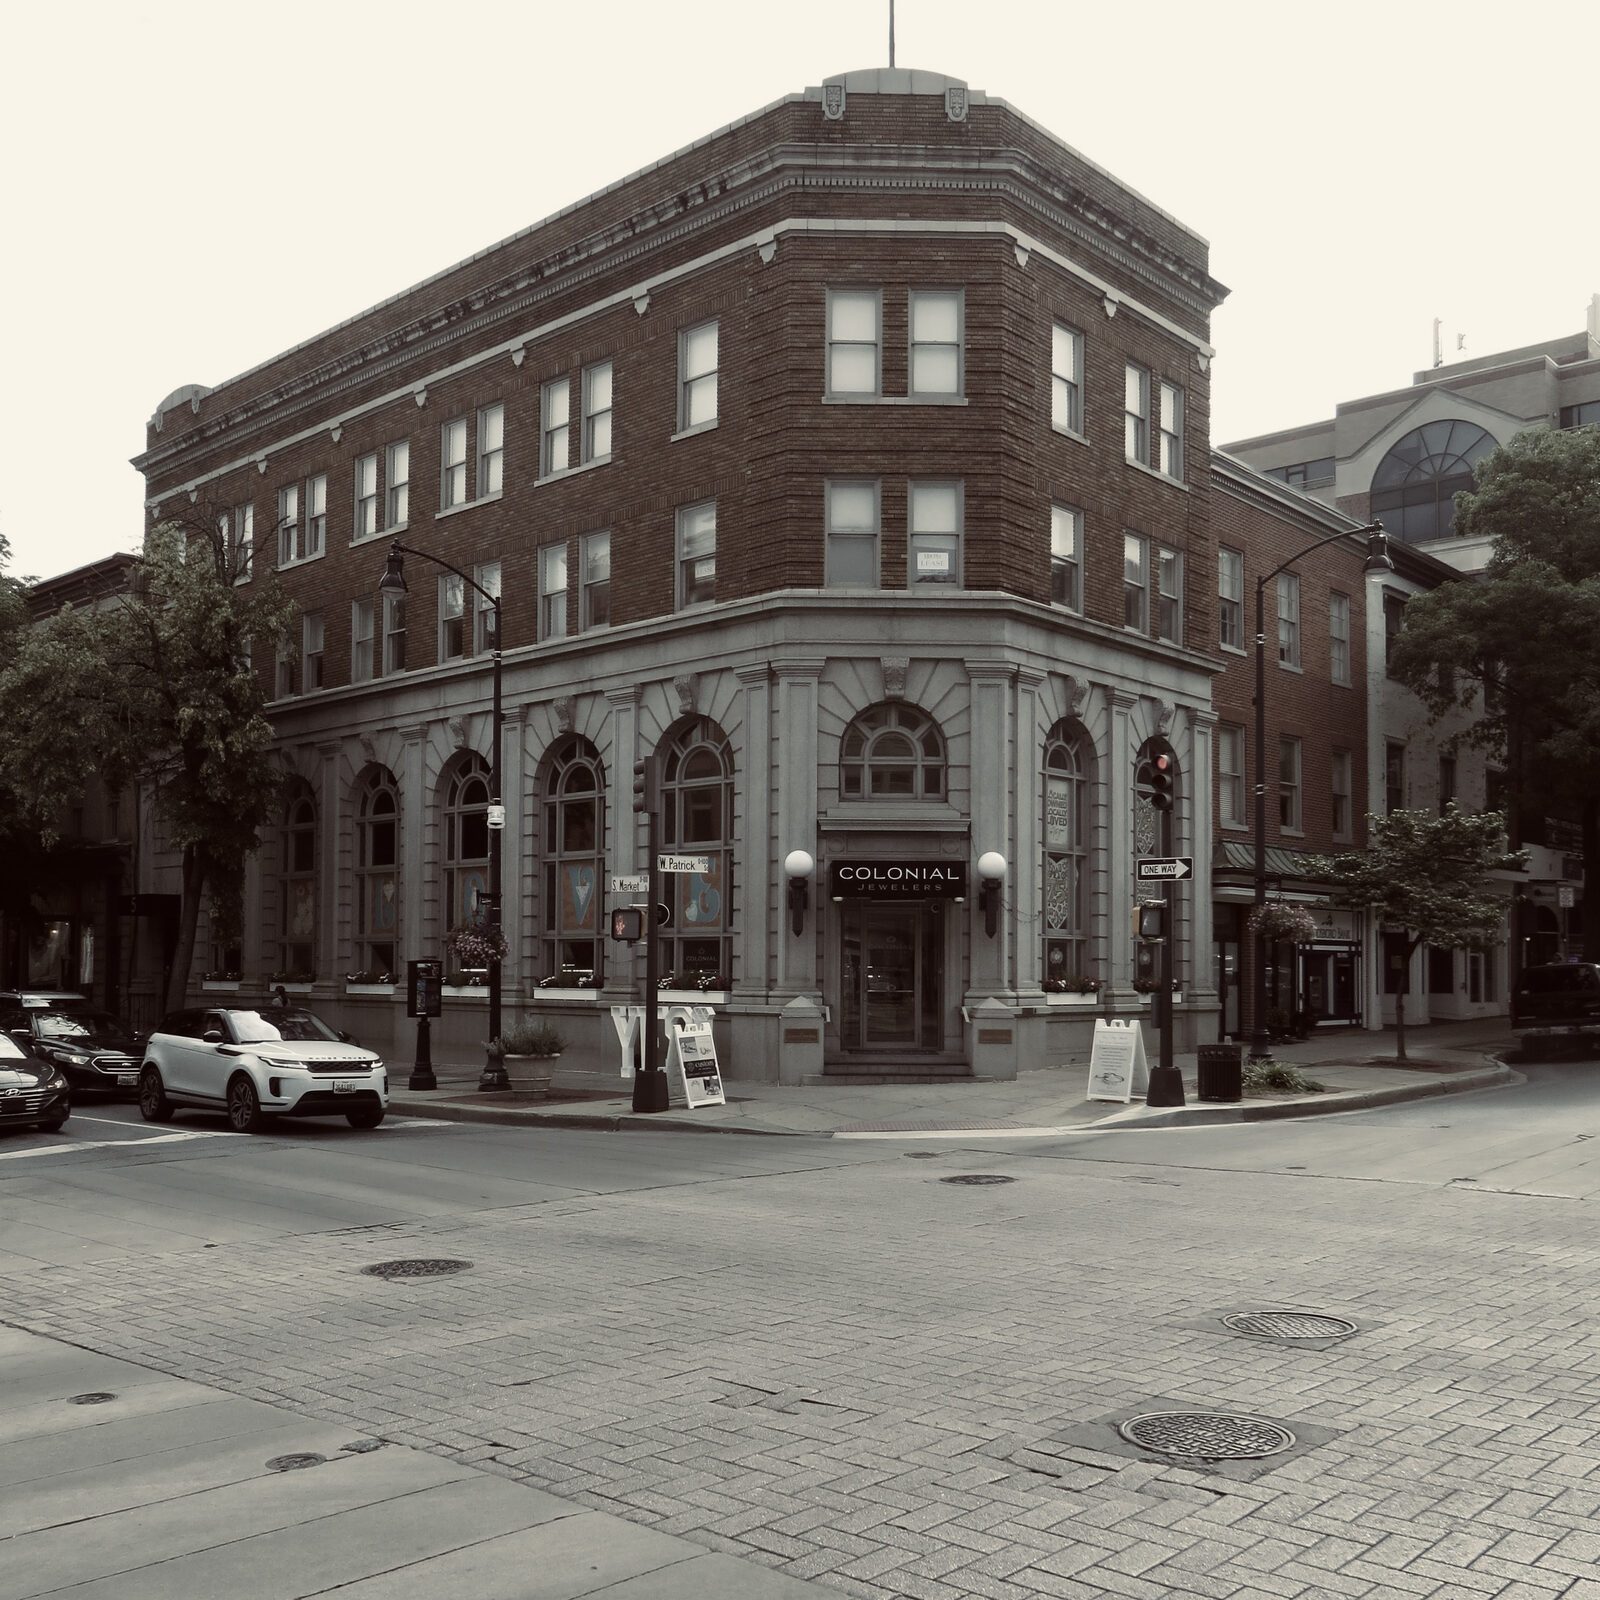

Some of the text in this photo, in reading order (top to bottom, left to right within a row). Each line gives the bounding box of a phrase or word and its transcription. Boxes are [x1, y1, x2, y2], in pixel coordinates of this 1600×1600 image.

[669, 858, 695, 870] Patrick
[1144, 865, 1176, 874] ONE WAY
[839, 867, 959, 880] COLONIAL
[619, 880, 639, 891] Market
